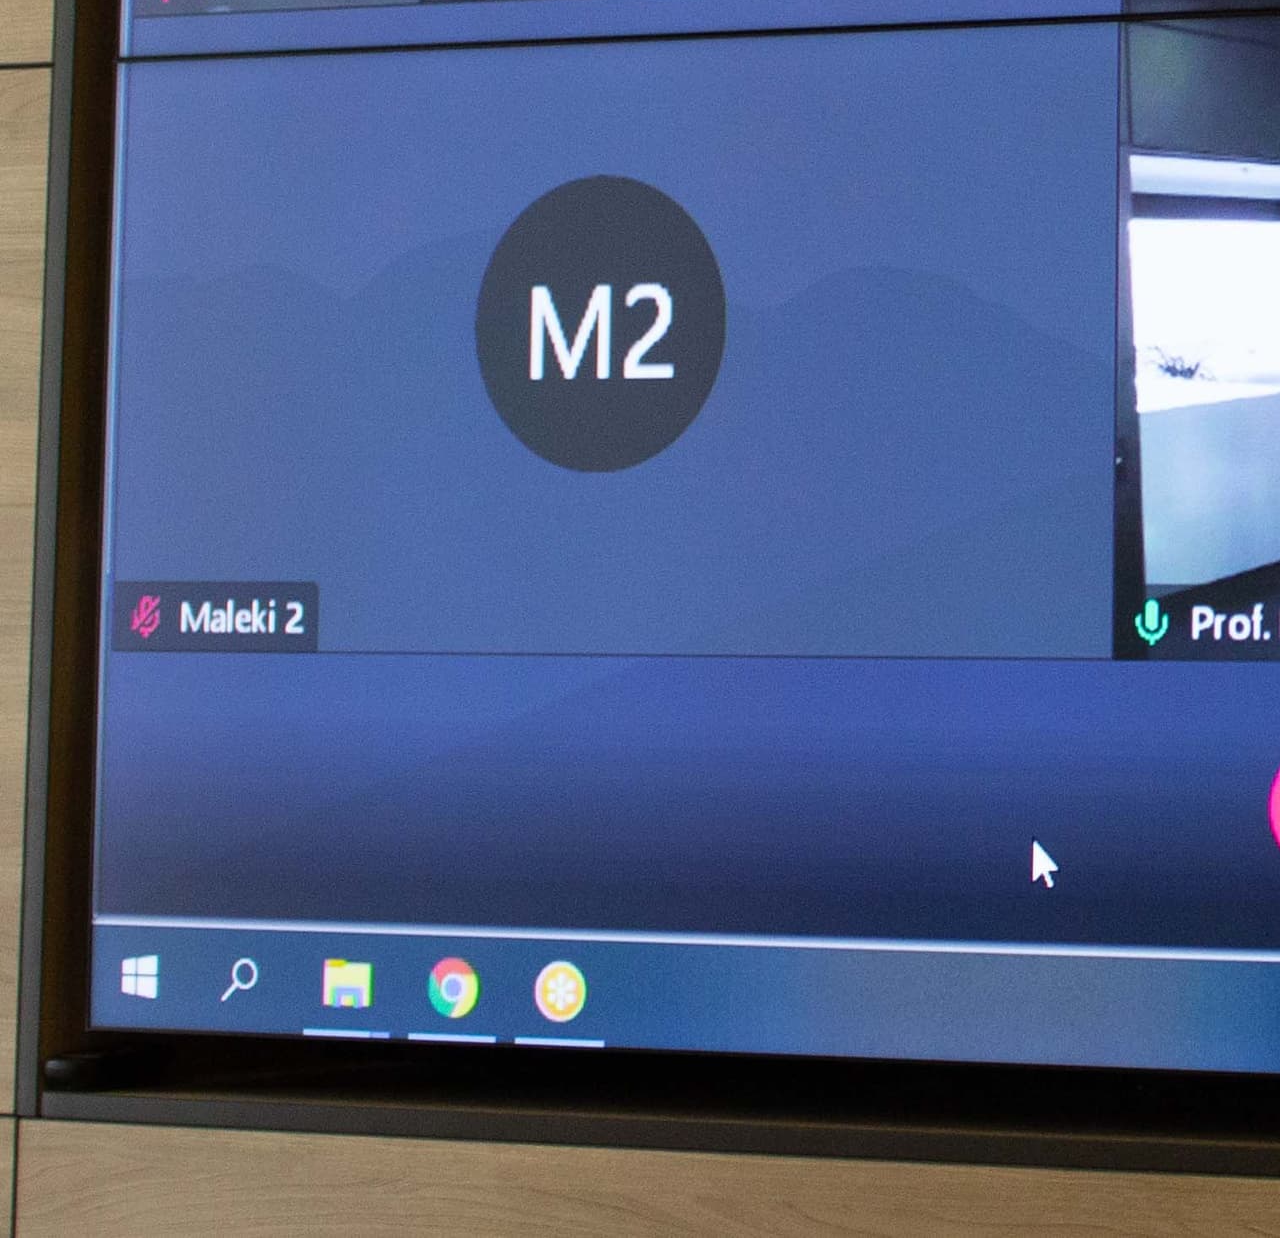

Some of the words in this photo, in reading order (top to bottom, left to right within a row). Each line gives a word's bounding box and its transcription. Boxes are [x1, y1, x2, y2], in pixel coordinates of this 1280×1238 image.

[529, 282, 675, 382] M2
[180, 599, 276, 635] Maleki
[284, 602, 305, 635] 2
[1190, 603, 1271, 641] Prof.
